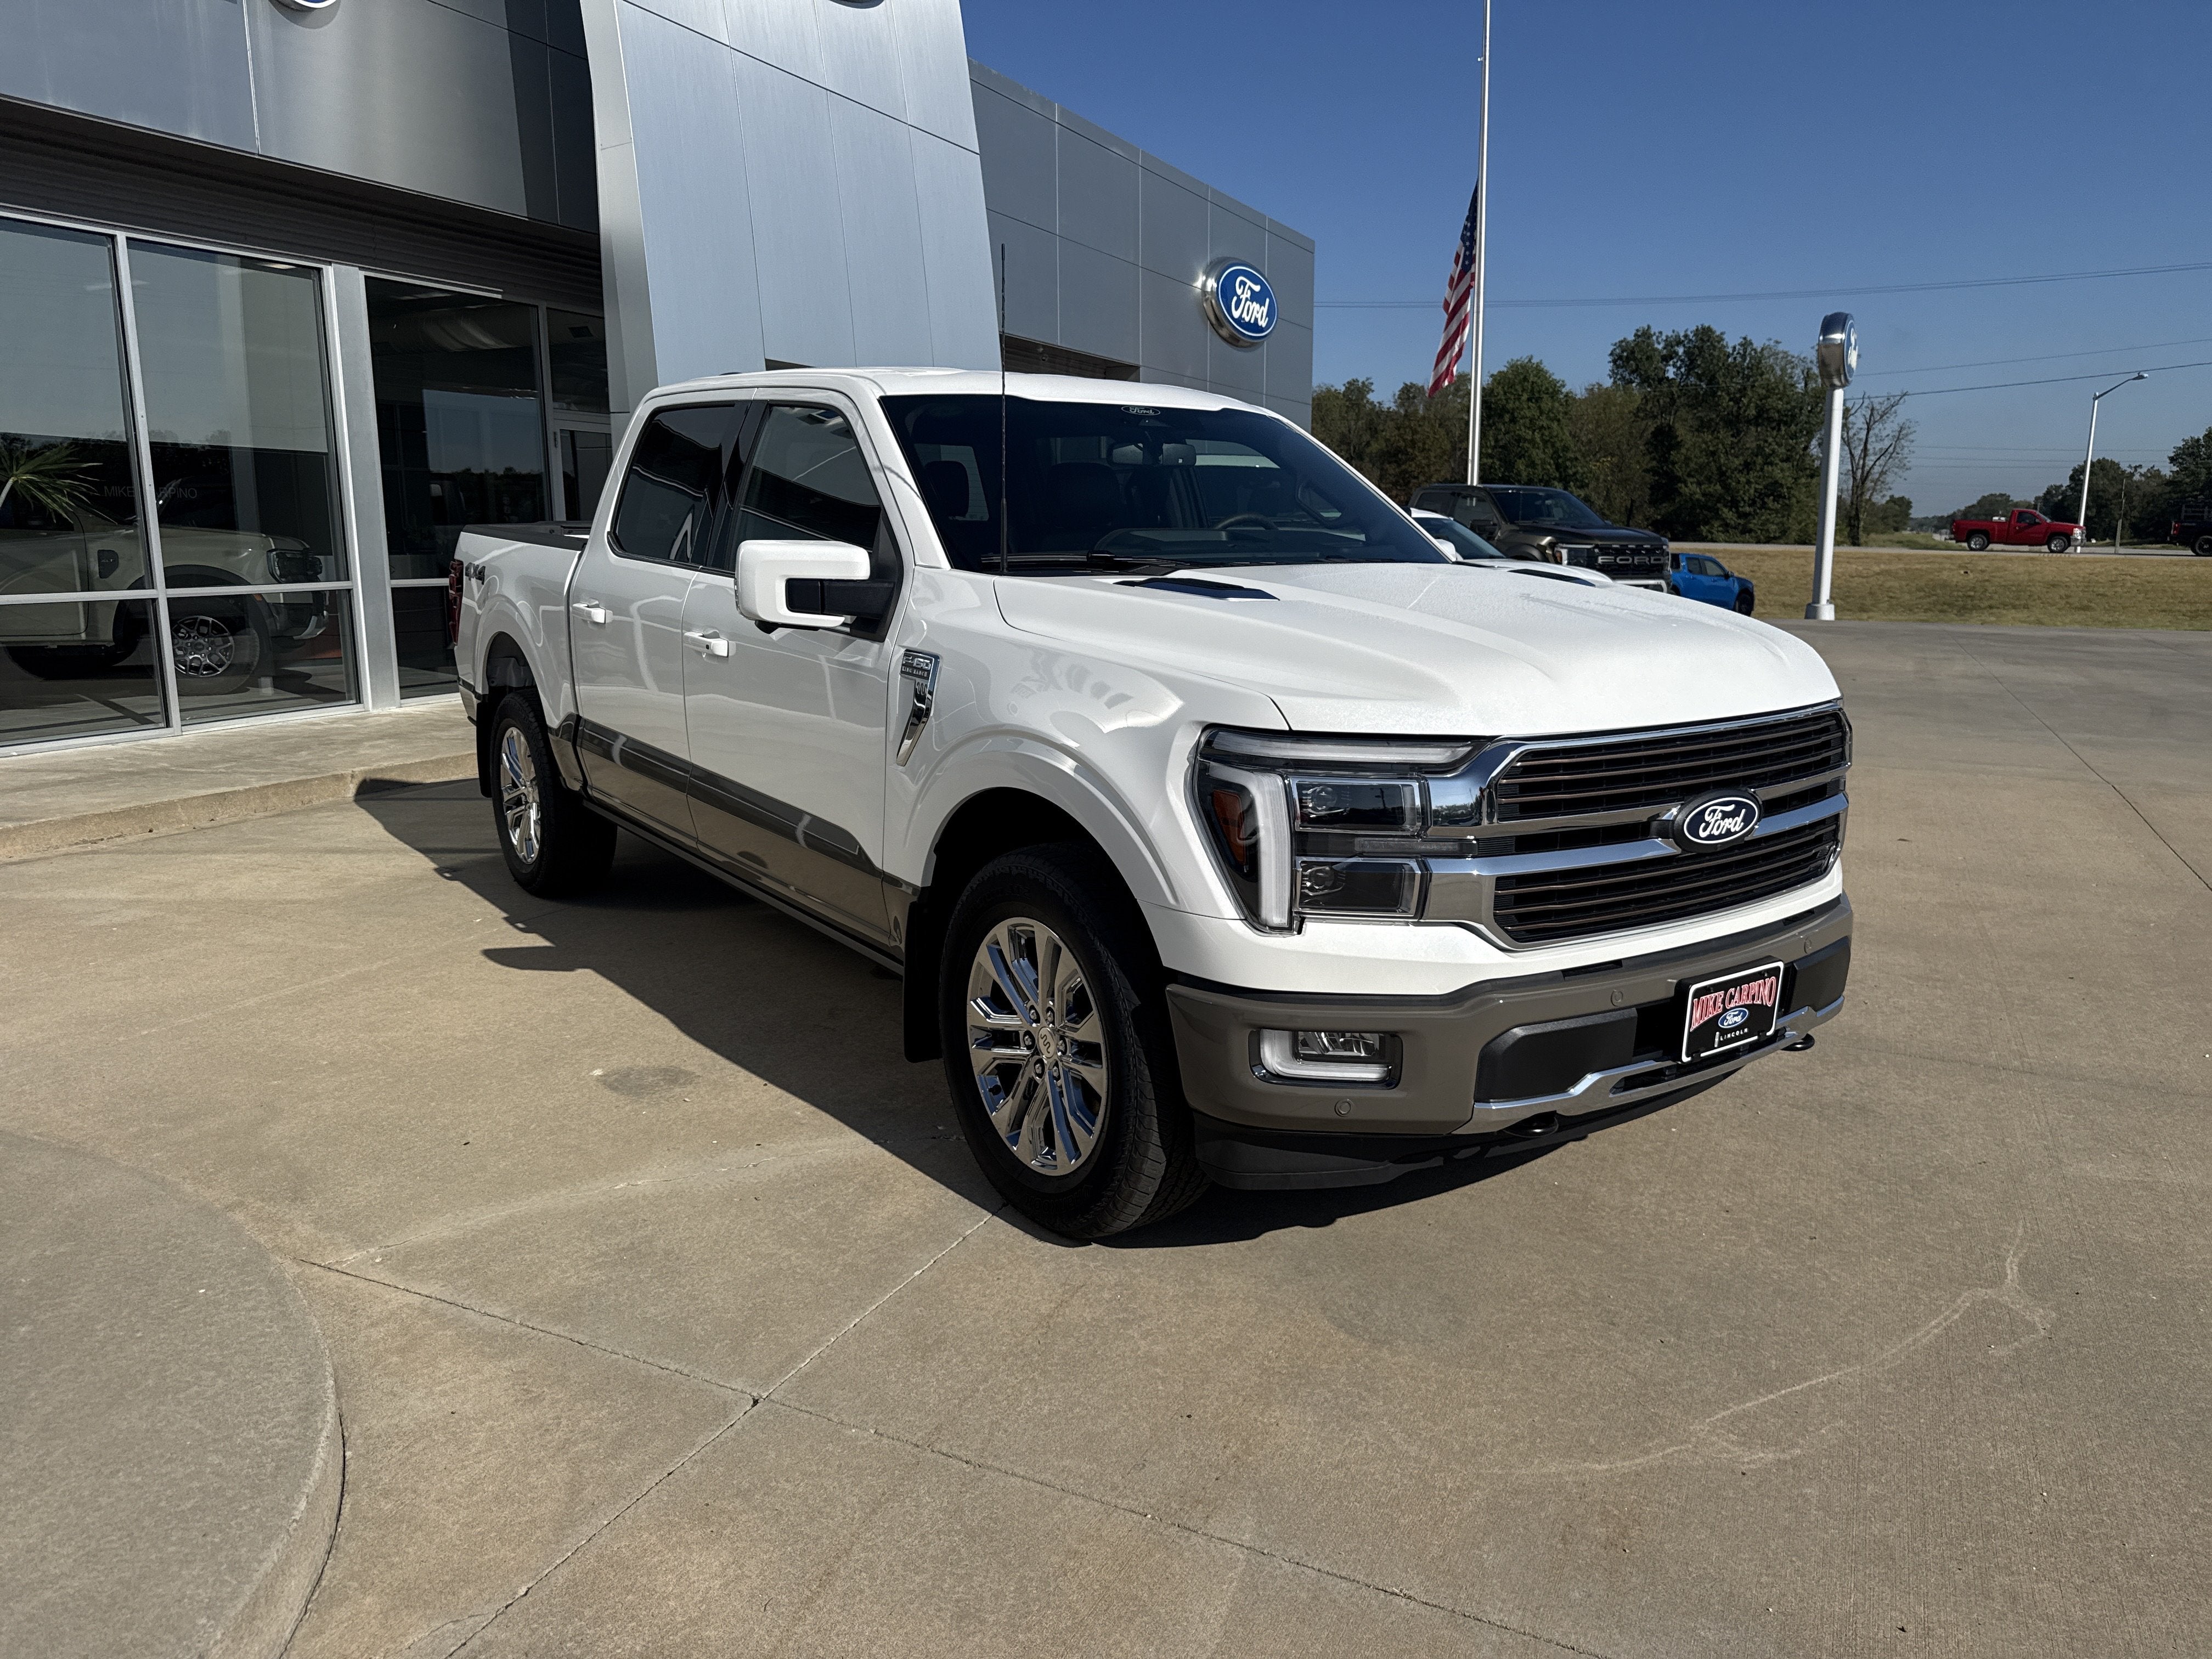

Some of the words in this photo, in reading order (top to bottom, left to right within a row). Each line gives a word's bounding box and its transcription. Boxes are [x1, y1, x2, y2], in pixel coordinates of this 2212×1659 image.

[1232, 276, 1269, 328] Ford
[104, 486, 135, 497] MIKE
[159, 487, 198, 499] RPINO
[1598, 556, 1664, 566] FORD
[1699, 804, 1746, 838] Ford
[1690, 991, 1724, 1032] MIKE
[1725, 976, 1776, 1009] CARPINO
[1724, 1011, 1743, 1026] Ford
[1720, 1028, 1748, 1041] LINCOLN
